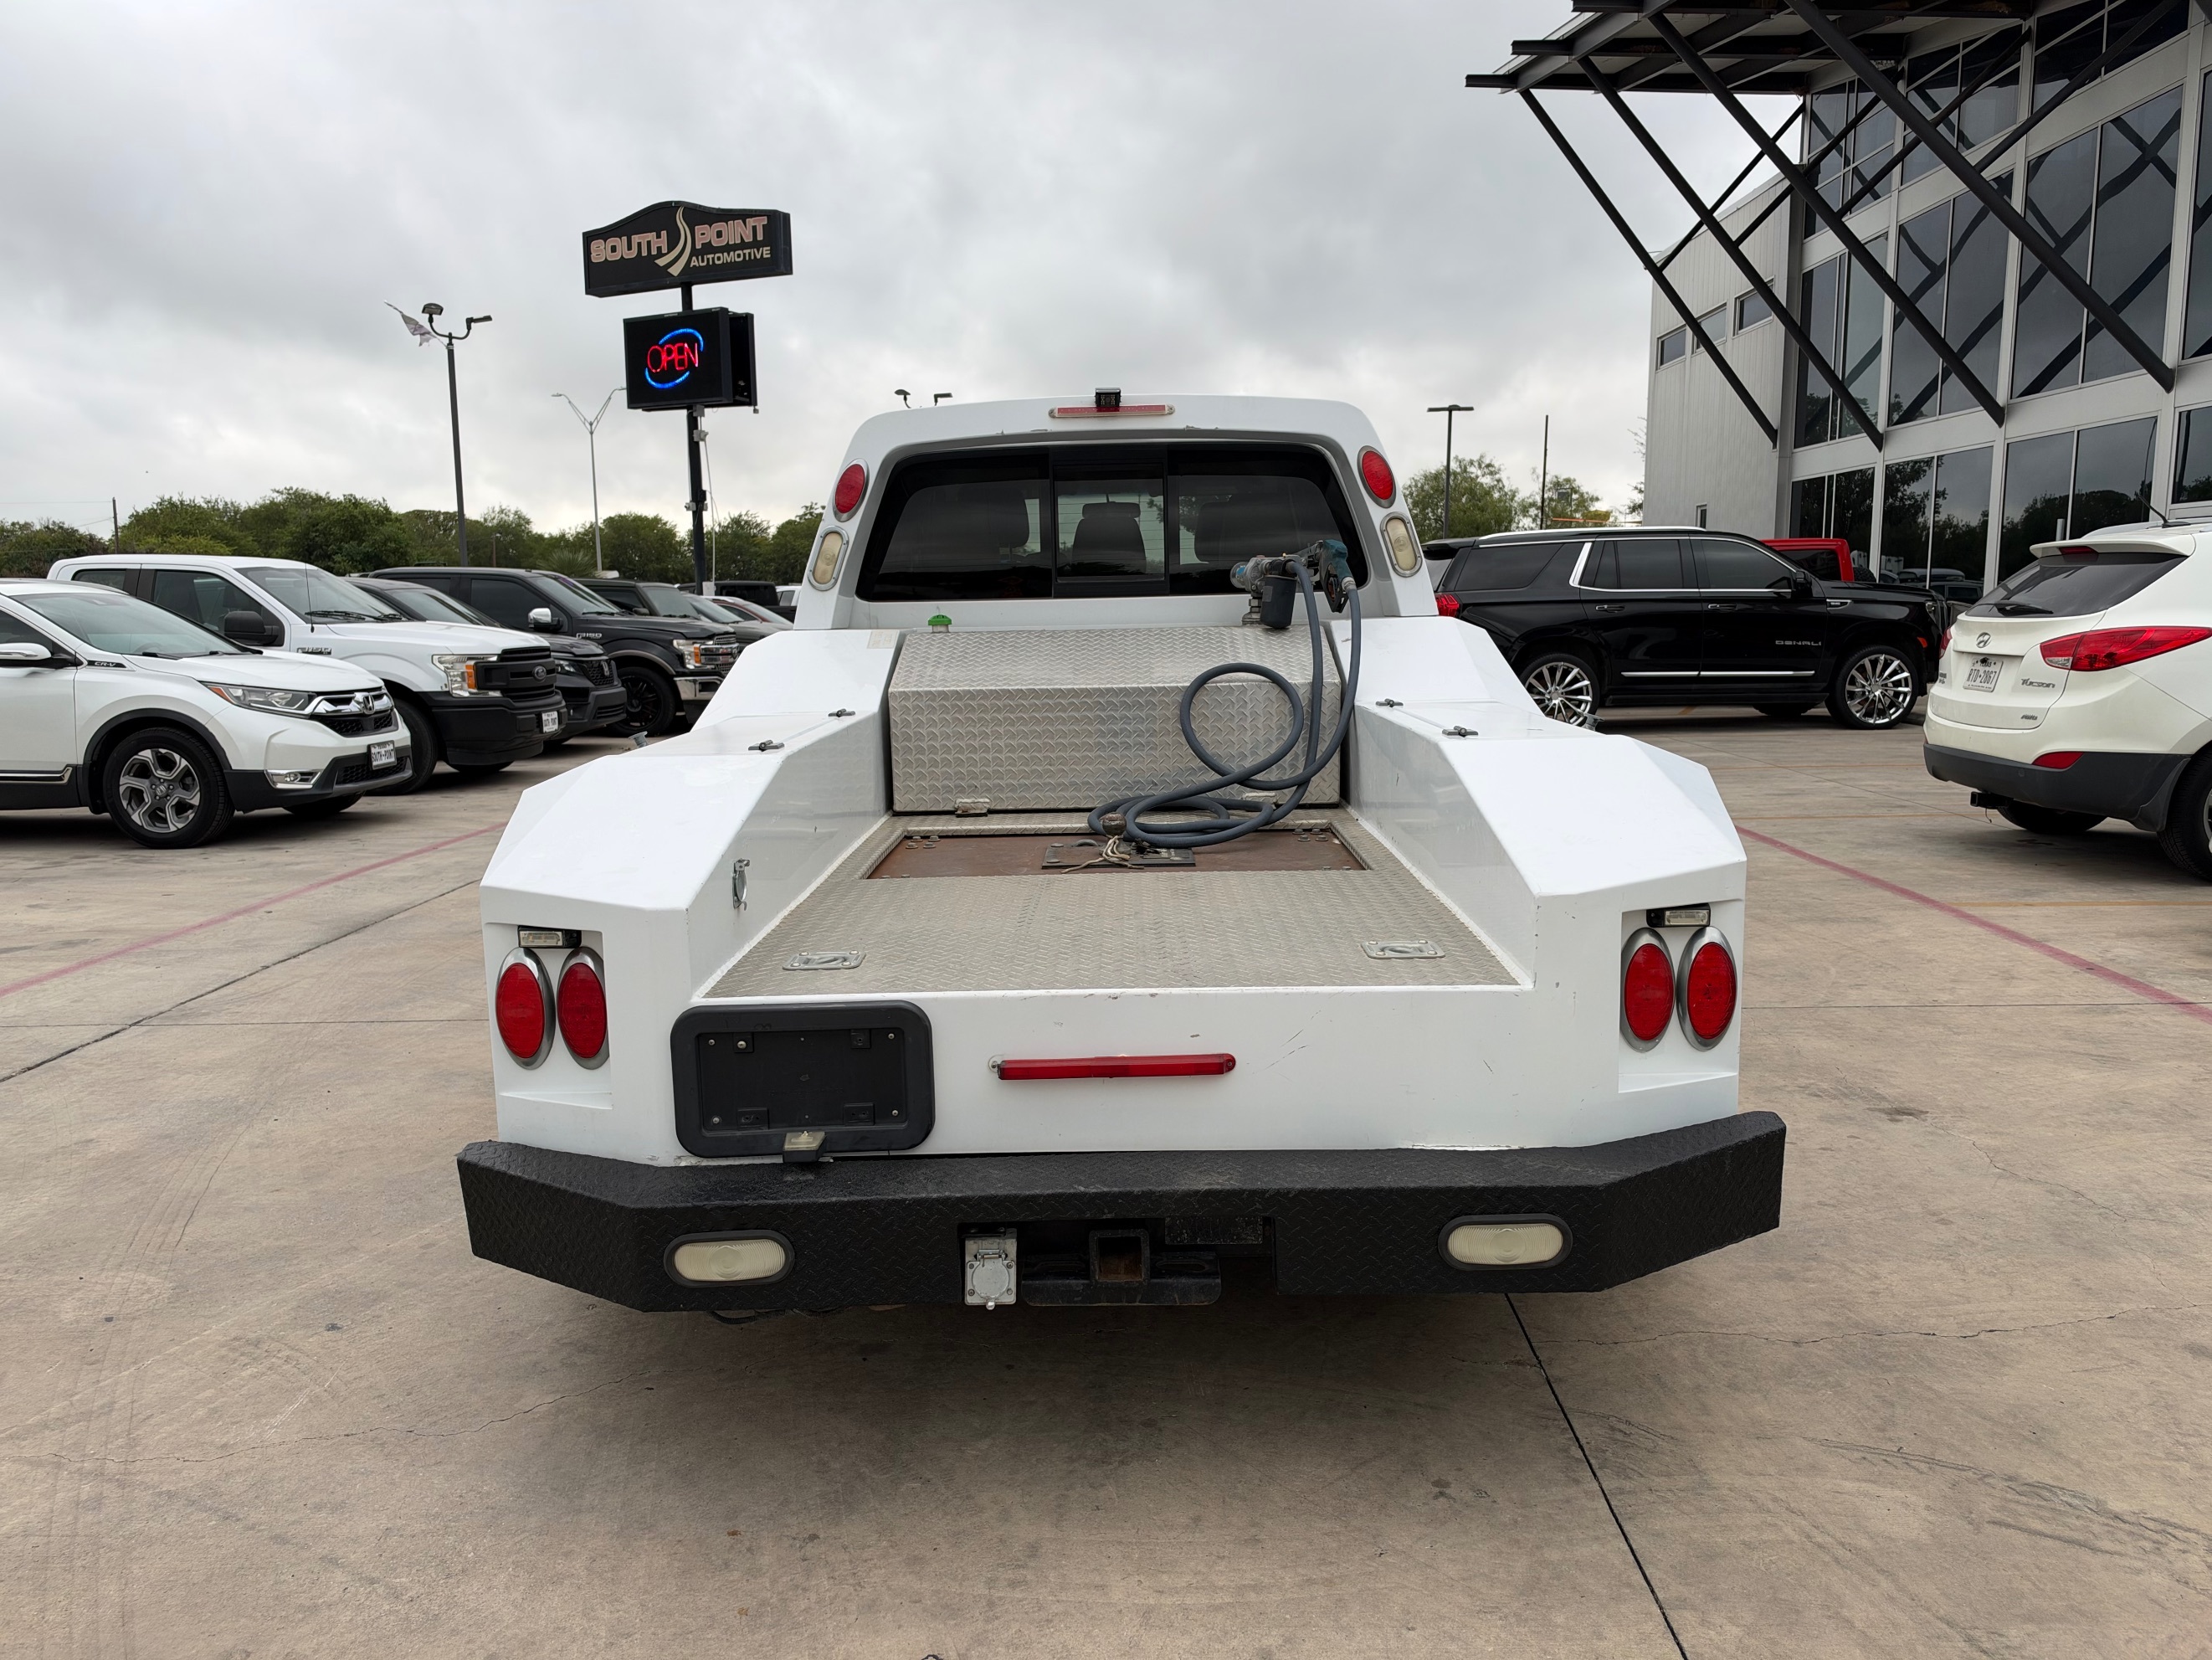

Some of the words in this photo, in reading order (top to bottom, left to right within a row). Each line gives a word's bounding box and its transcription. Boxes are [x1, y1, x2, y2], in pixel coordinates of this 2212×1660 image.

[591, 230, 668, 263] SOUTH
[694, 216, 768, 249] POINT
[690, 246, 772, 268] AUTOMOTIVE
[647, 342, 699, 373] OPEN
